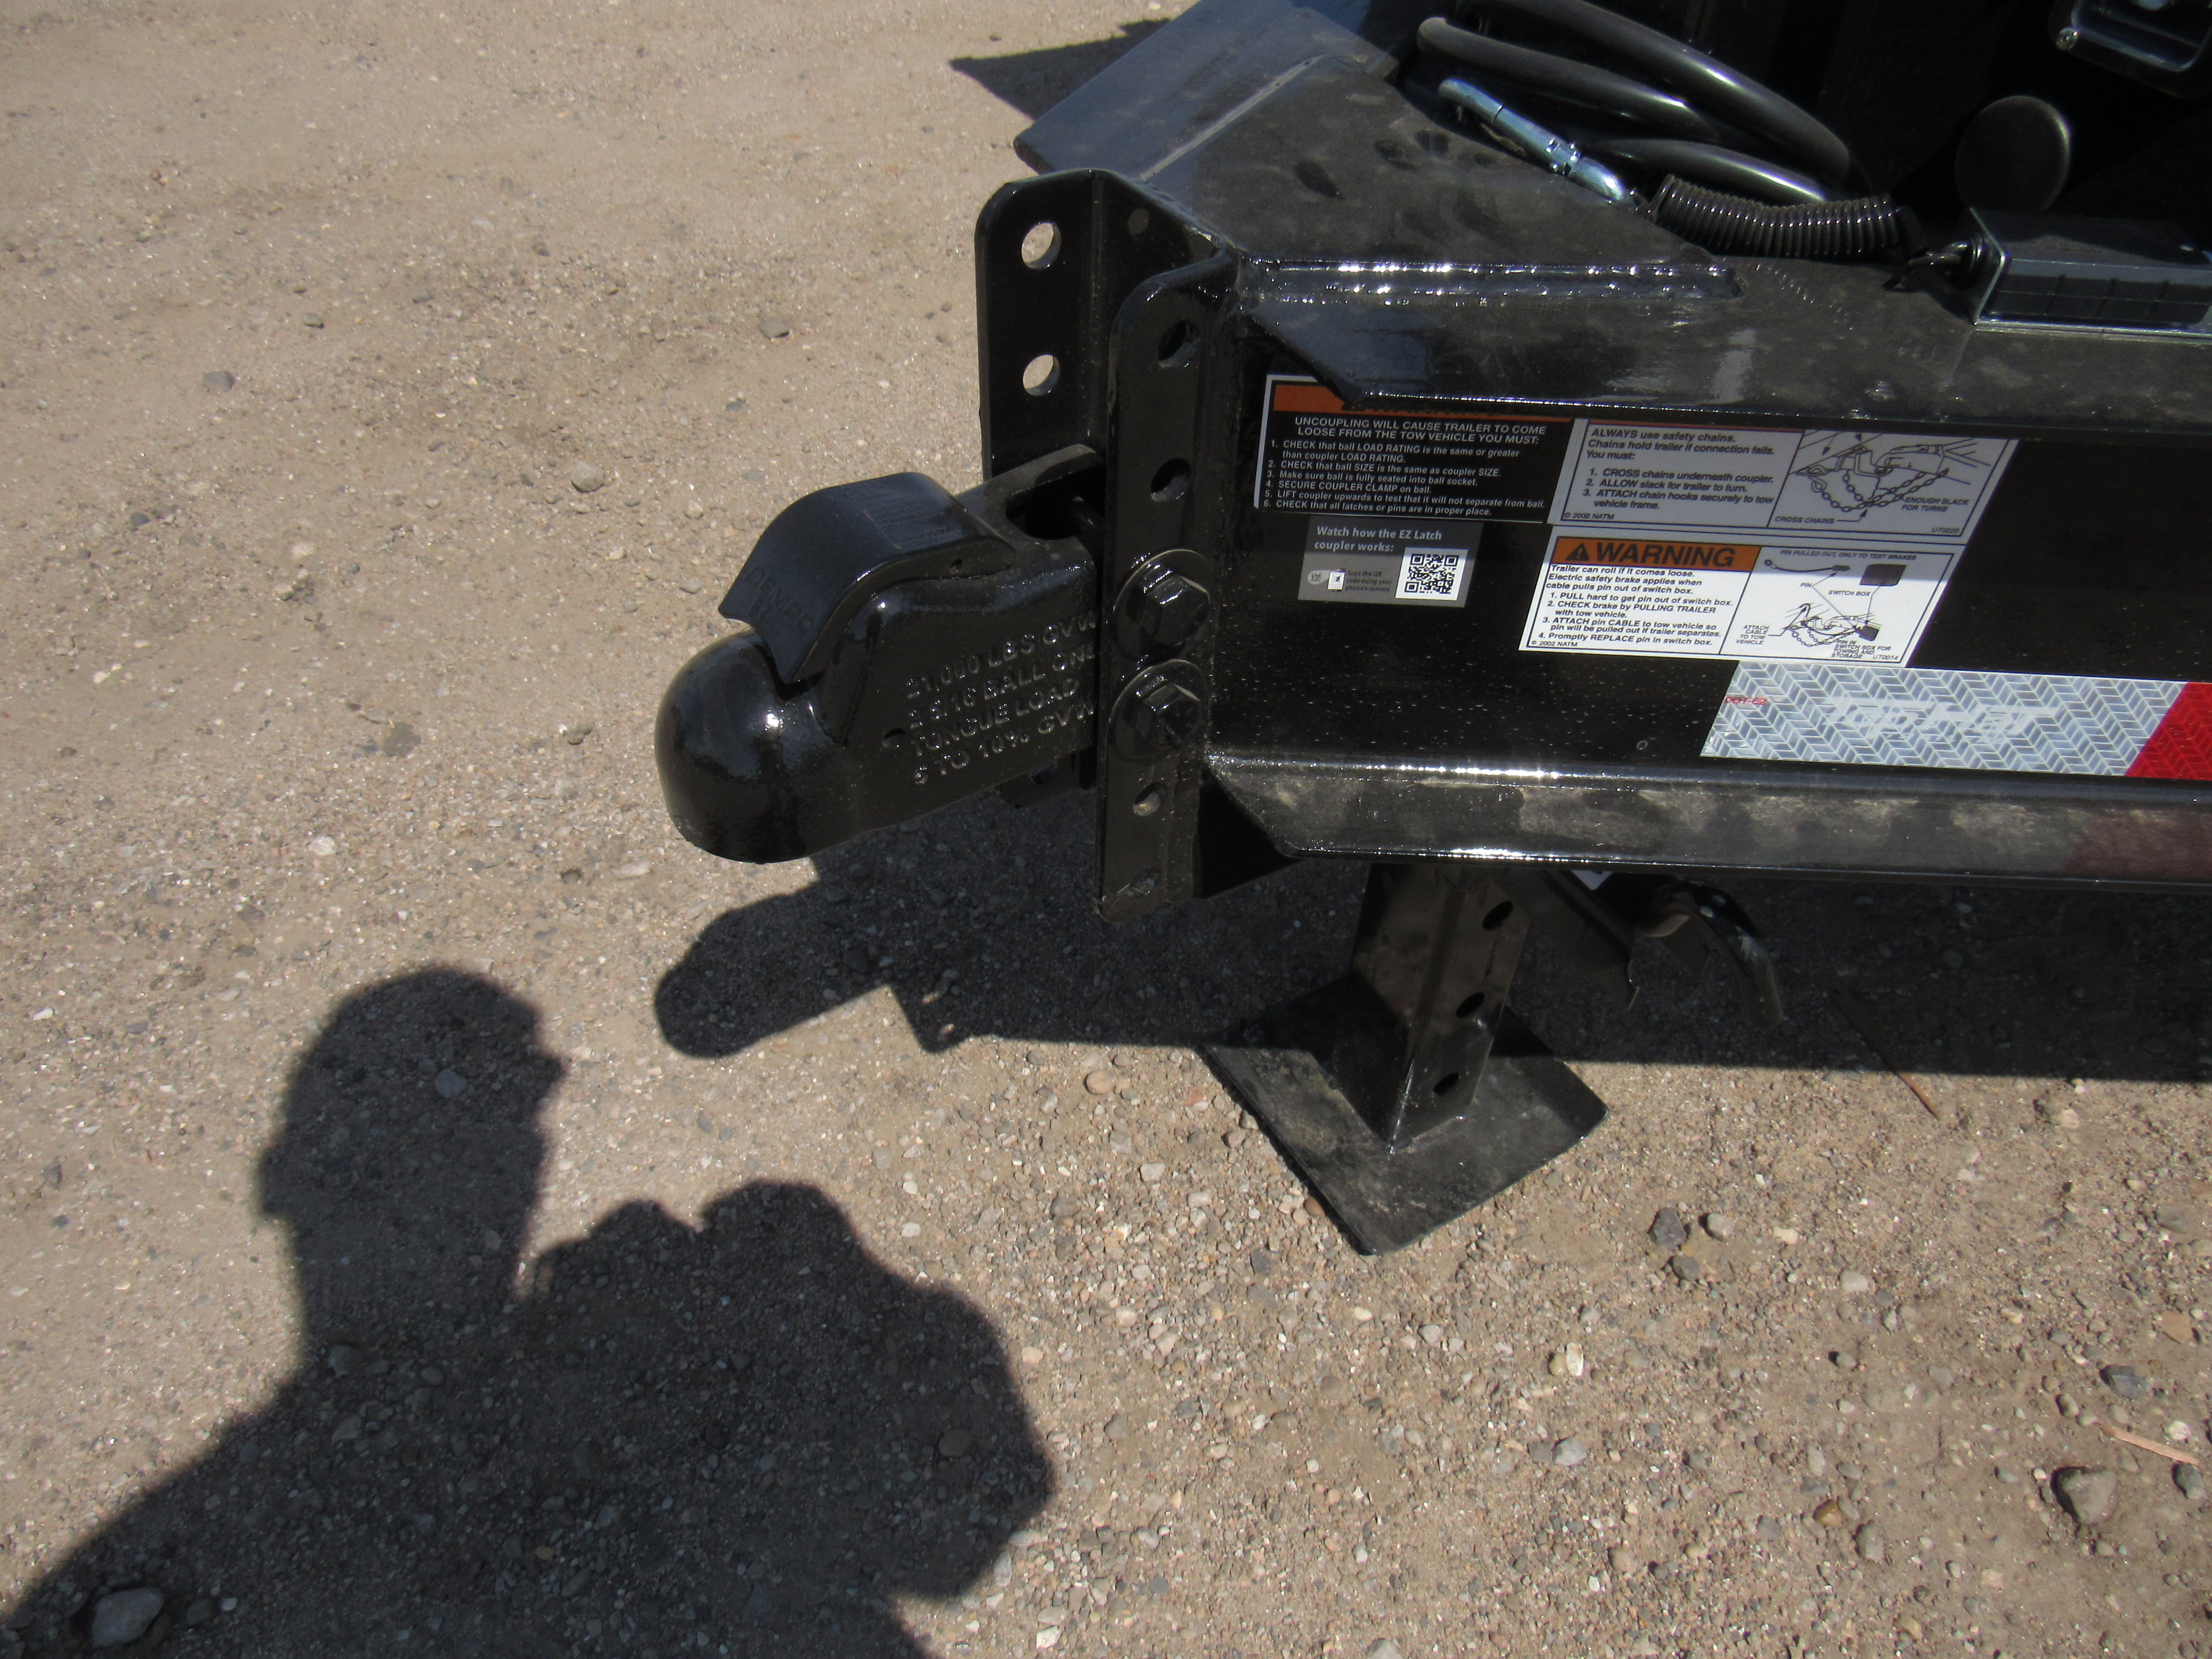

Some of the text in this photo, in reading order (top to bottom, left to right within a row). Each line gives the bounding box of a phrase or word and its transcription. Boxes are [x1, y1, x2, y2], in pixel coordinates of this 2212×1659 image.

[1295, 417, 1546, 434] UNCOUPLING WILL CAUSE TRAILER TO COME
[1298, 427, 1539, 444] LOOSE FROM THE TOW VEHICLE YOU MUST:
[1591, 429, 1637, 438] ALWAYS
[1662, 432, 1695, 442] safety
[1697, 433, 1735, 442] chains.
[1283, 440, 1315, 449] CHECK
[1319, 442, 1335, 450] that
[1358, 443, 1383, 452] LOAD
[1386, 444, 1420, 453] RATING
[1488, 450, 1519, 458] greater
[1587, 450, 1605, 458] You
[1588, 439, 1625, 448] Chains
[1628, 441, 1652, 450] hold
[1655, 443, 1683, 451] trailer
[1685, 443, 1693, 451] if
[1752, 446, 1774, 455] fails.
[1305, 452, 1338, 460] coupler
[1341, 453, 1366, 461] LOAD
[1369, 454, 1405, 463] RATING.
[1281, 460, 1312, 469] CHECK
[1316, 460, 1333, 470] that
[1354, 463, 1374, 472] SIZE
[1443, 468, 1476, 477] coupler
[1479, 469, 1500, 477] SIZE.
[1603, 468, 1640, 478] CROSS
[1642, 470, 1675, 479] chains
[1677, 472, 1733, 481] underneath
[1735, 475, 1773, 484] coupler.
[1279, 481, 1316, 489] SECURE
[1319, 482, 1362, 491] COUPLER
[1366, 484, 1397, 492] CLAMP
[1276, 500, 1307, 508] CHECK
[1342, 503, 1373, 511] latches
[1387, 504, 1406, 513] pins
[1466, 508, 1491, 516] place.
[1317, 526, 1442, 540] Watch how the EZ Latch
[1314, 541, 1394, 552] coupler works:
[1597, 543, 1734, 567] WARNING
[1548, 632, 1588, 641] Promptly
[987, 634, 1036, 668] LBS
[984, 661, 1046, 700] BALL
[1724, 696, 1767, 706] DOT-C2
[911, 678, 1080, 757] TONGUE LOAD
[935, 750, 971, 776] TO
[1037, 703, 1095, 734] GVW
